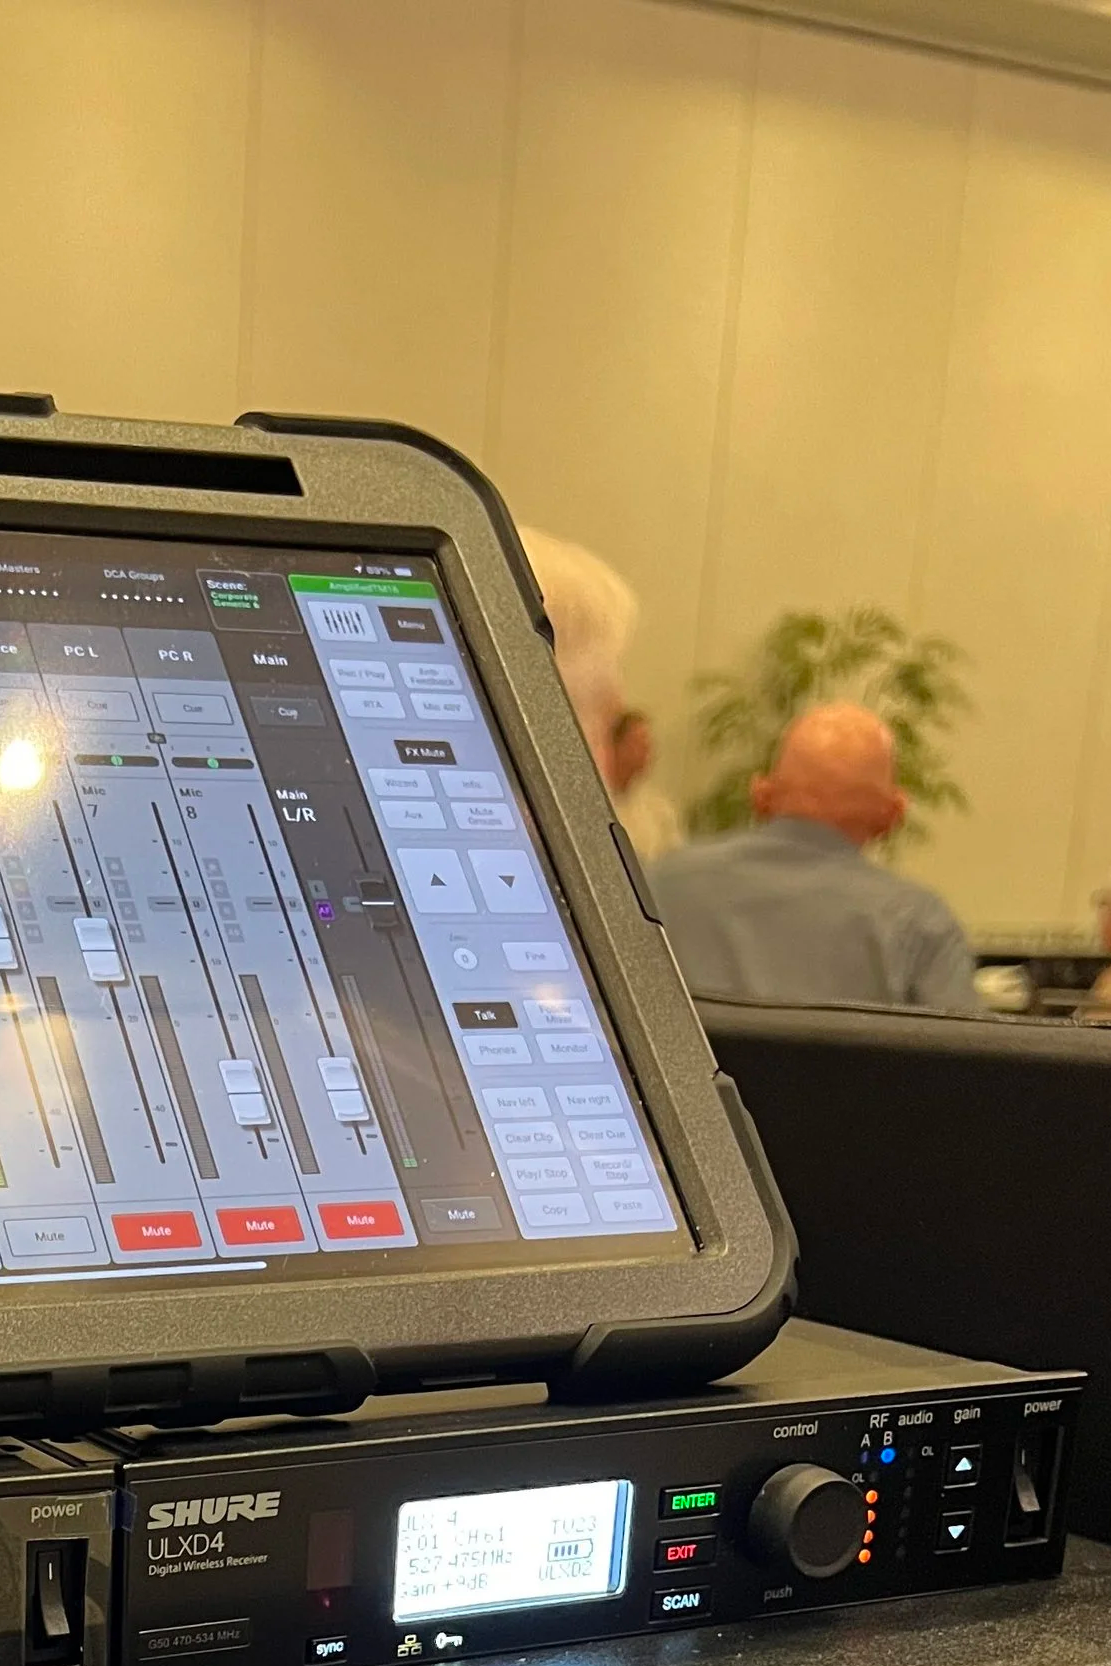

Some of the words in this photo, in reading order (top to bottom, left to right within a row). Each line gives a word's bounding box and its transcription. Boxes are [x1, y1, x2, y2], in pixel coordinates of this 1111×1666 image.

[103, 569, 125, 579] DCA
[128, 570, 165, 582] Groups
[206, 579, 247, 591] Scene:
[64, 645, 85, 657] PC
[88, 646, 99, 658] L
[158, 649, 179, 661] PC
[182, 651, 193, 662] R
[253, 654, 288, 667] Main
[276, 789, 308, 800] Main
[283, 807, 316, 823] L/R
[474, 1010, 497, 1021] Talk
[480, 1045, 518, 1056] Phones
[346, 1213, 375, 1227] Mute
[447, 1209, 476, 1220] Mute
[142, 1223, 172, 1238] Mute
[246, 1218, 276, 1233] Mute
[34, 1229, 66, 1243] Mute
[870, 1413, 890, 1429] RF
[898, 1410, 933, 1427] audio
[954, 1406, 981, 1424] gain
[1024, 1399, 1062, 1418] power
[773, 1421, 818, 1439] control
[671, 1492, 716, 1511] ENTER
[31, 1501, 83, 1522] power
[147, 1491, 281, 1530] SHURE
[148, 1531, 225, 1561] ULXD4
[667, 1544, 697, 1561] EXIT
[148, 1562, 182, 1577] Digital
[184, 1558, 224, 1571] Wireless
[226, 1554, 268, 1567] Receiver
[764, 1585, 793, 1602] push
[662, 1593, 700, 1611] SCAN
[217, 1629, 240, 1641] MHz
[316, 1640, 344, 1658] sync
